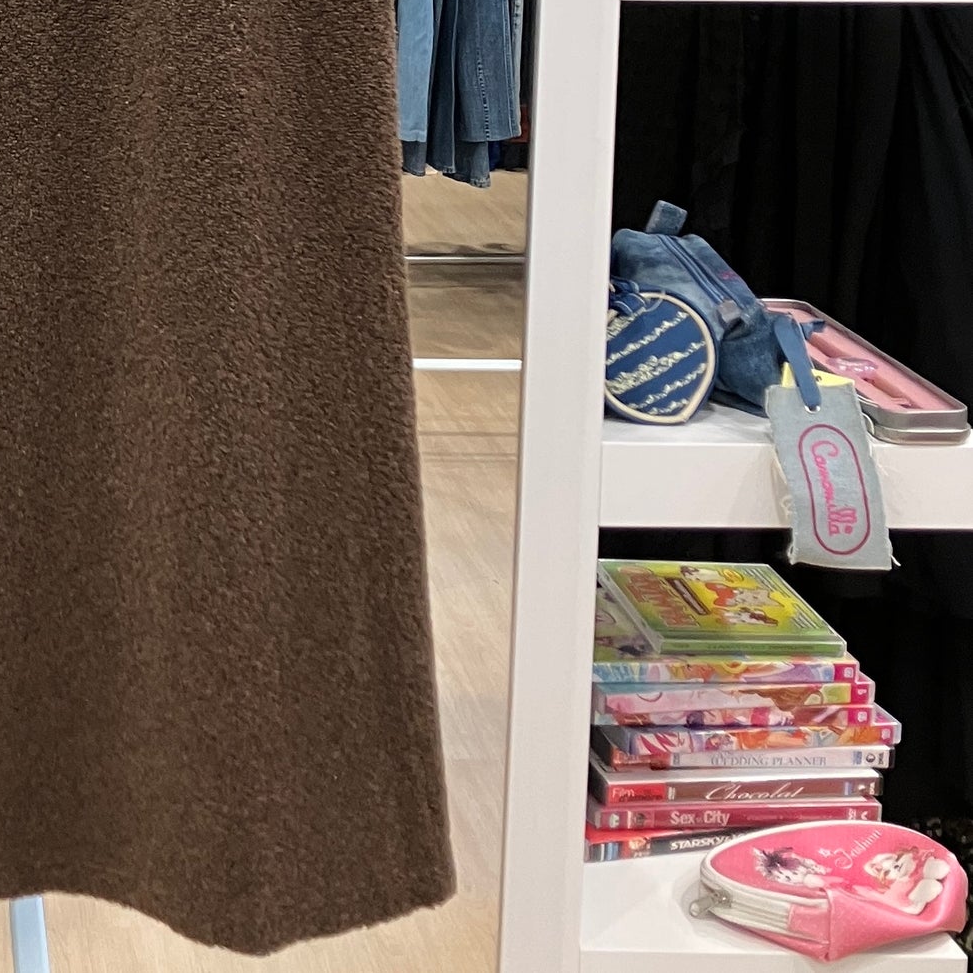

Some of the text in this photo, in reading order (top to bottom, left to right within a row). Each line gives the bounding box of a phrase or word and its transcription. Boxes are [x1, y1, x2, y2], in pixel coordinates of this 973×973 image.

[772, 756, 826, 766] PLANNER
[706, 782, 804, 800] Chocolat
[670, 811, 695, 825] Sex
[704, 810, 730, 826] City
[670, 835, 723, 851] STARSKY
